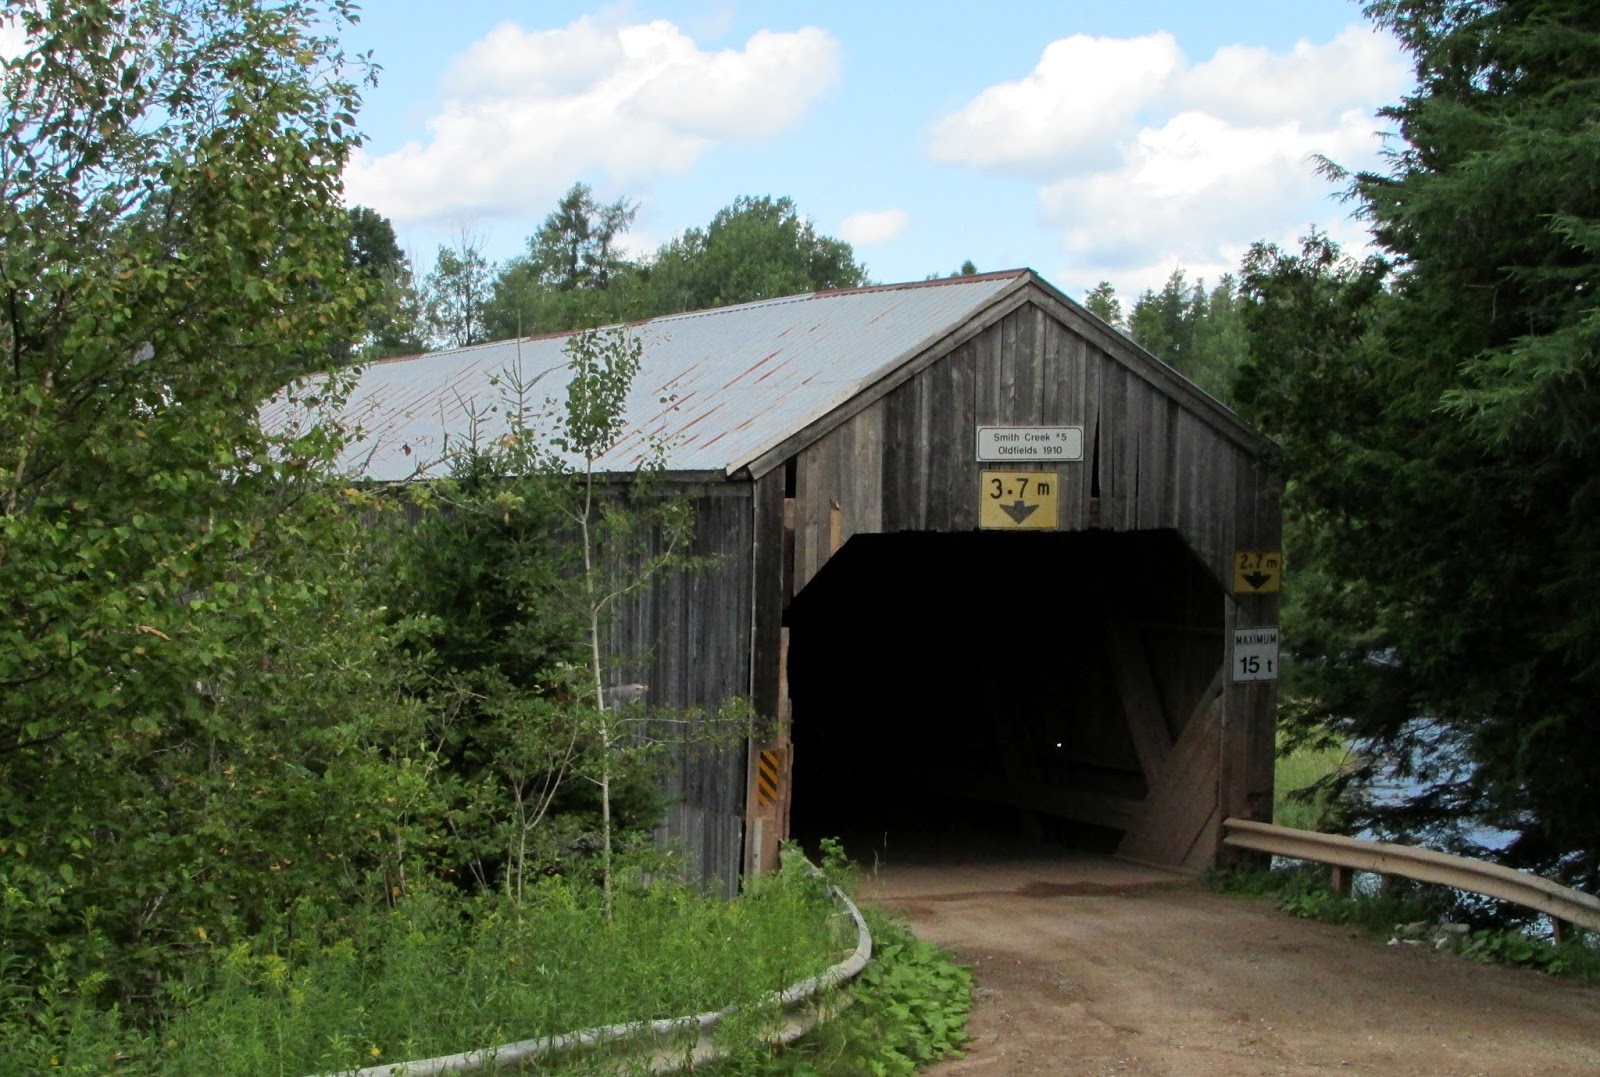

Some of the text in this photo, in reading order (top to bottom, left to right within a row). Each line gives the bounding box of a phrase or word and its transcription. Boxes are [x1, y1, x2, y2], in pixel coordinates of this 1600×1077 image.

[993, 433, 1020, 442] Smith
[1024, 433, 1051, 442] Creek
[998, 446, 1063, 455] Oldfields 1910
[990, 478, 1050, 499] 3.7 m
[1240, 554, 1277, 570] 2.7 m
[1235, 634, 1277, 646] MAXIMUM
[1240, 656, 1273, 674] 15 t
